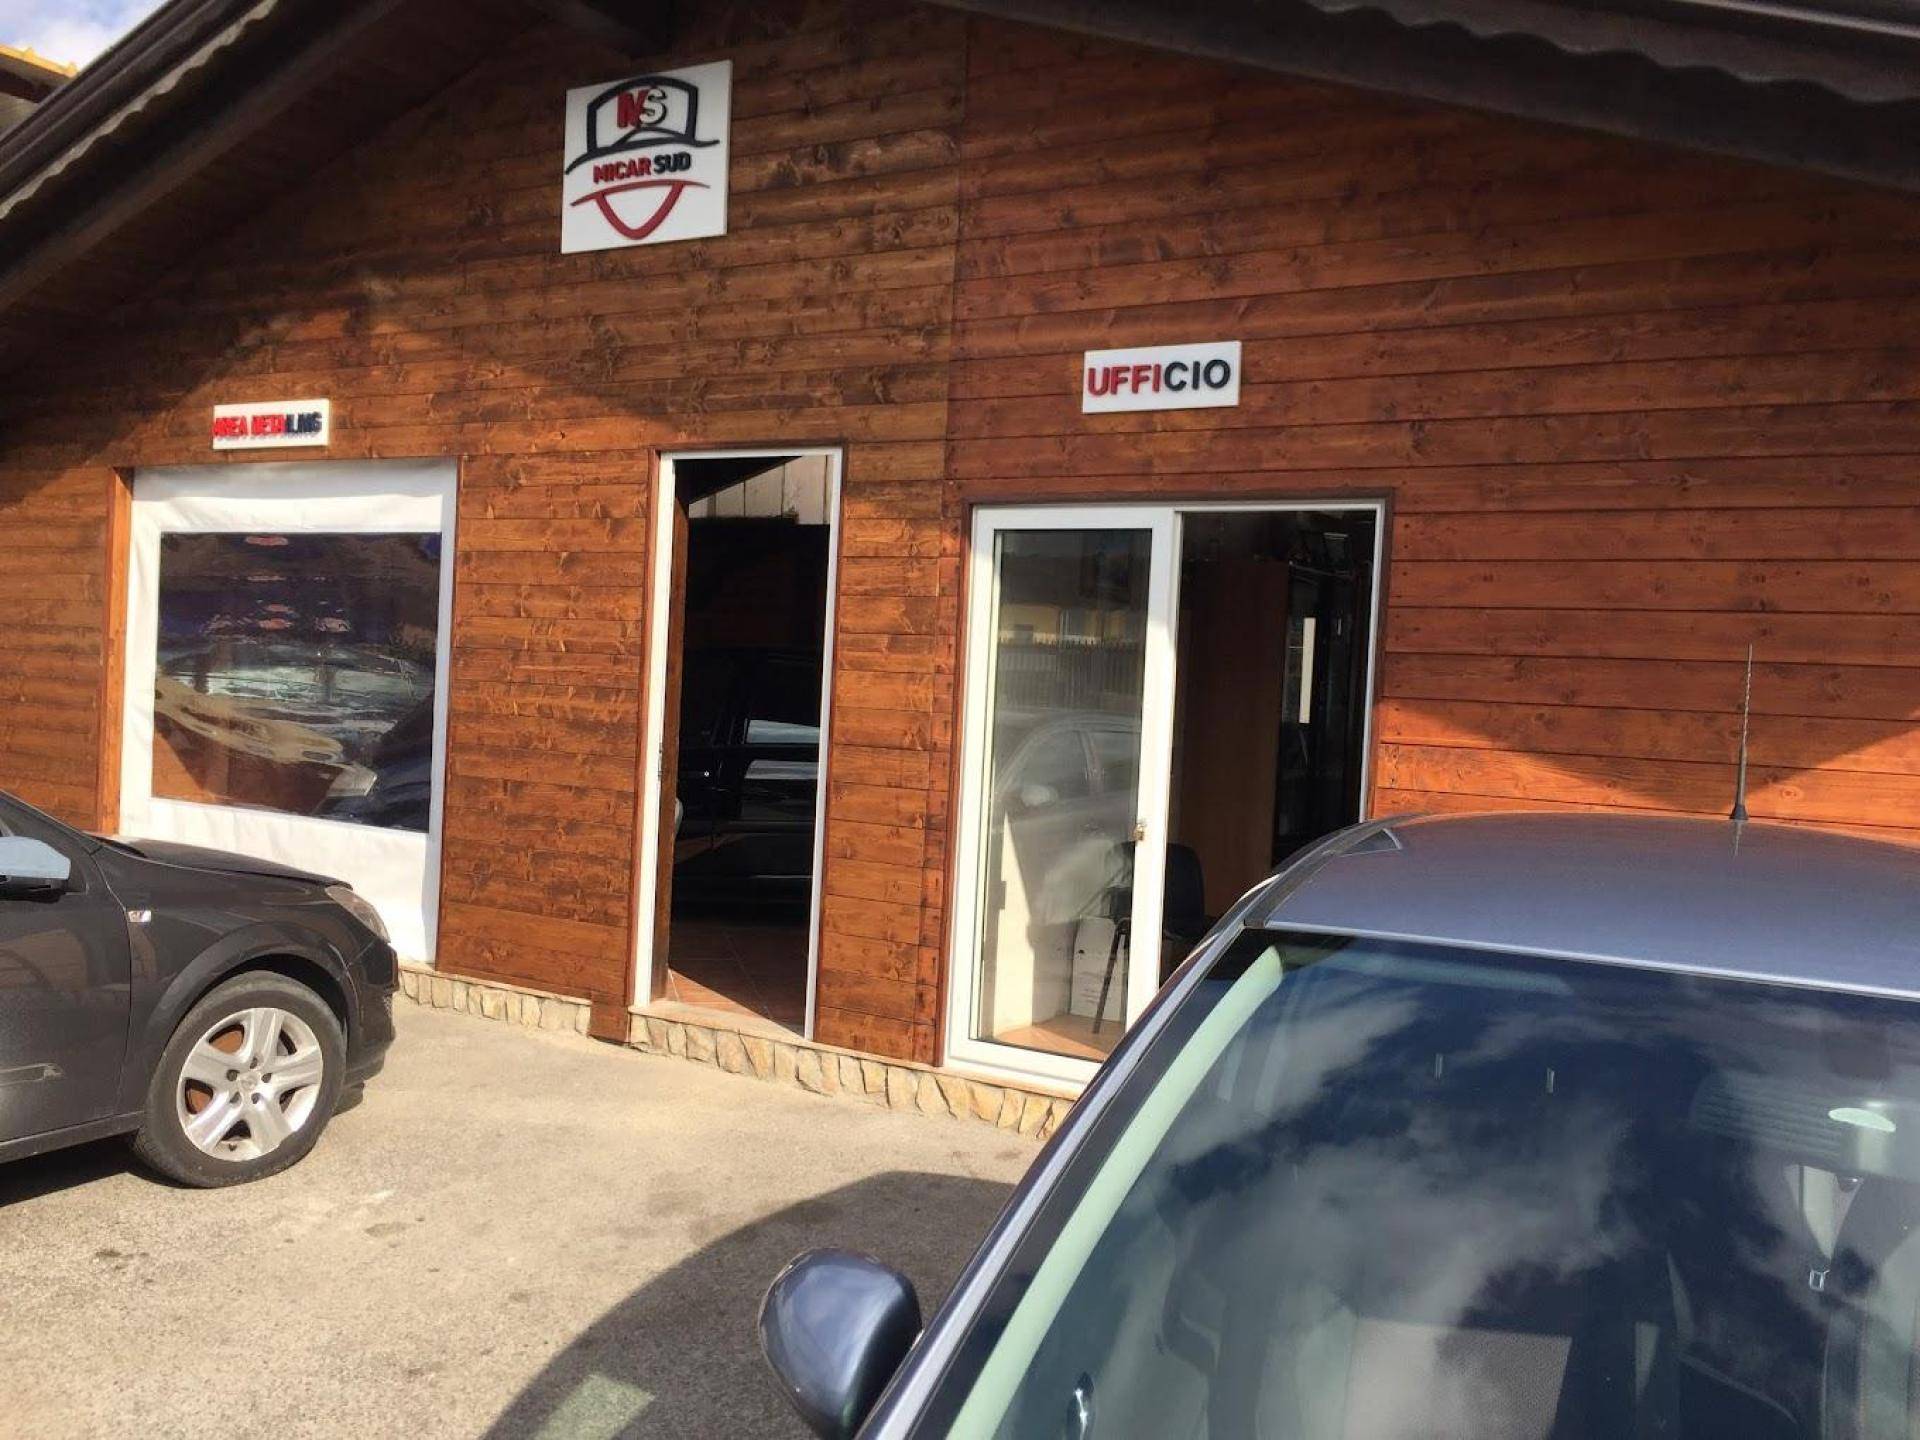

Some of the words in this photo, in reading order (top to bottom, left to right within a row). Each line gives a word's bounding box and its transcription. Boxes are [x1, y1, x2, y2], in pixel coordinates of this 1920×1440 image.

[653, 151, 692, 174] SUD
[1087, 359, 1231, 396] UFFICIO
[213, 416, 248, 437] AREA
